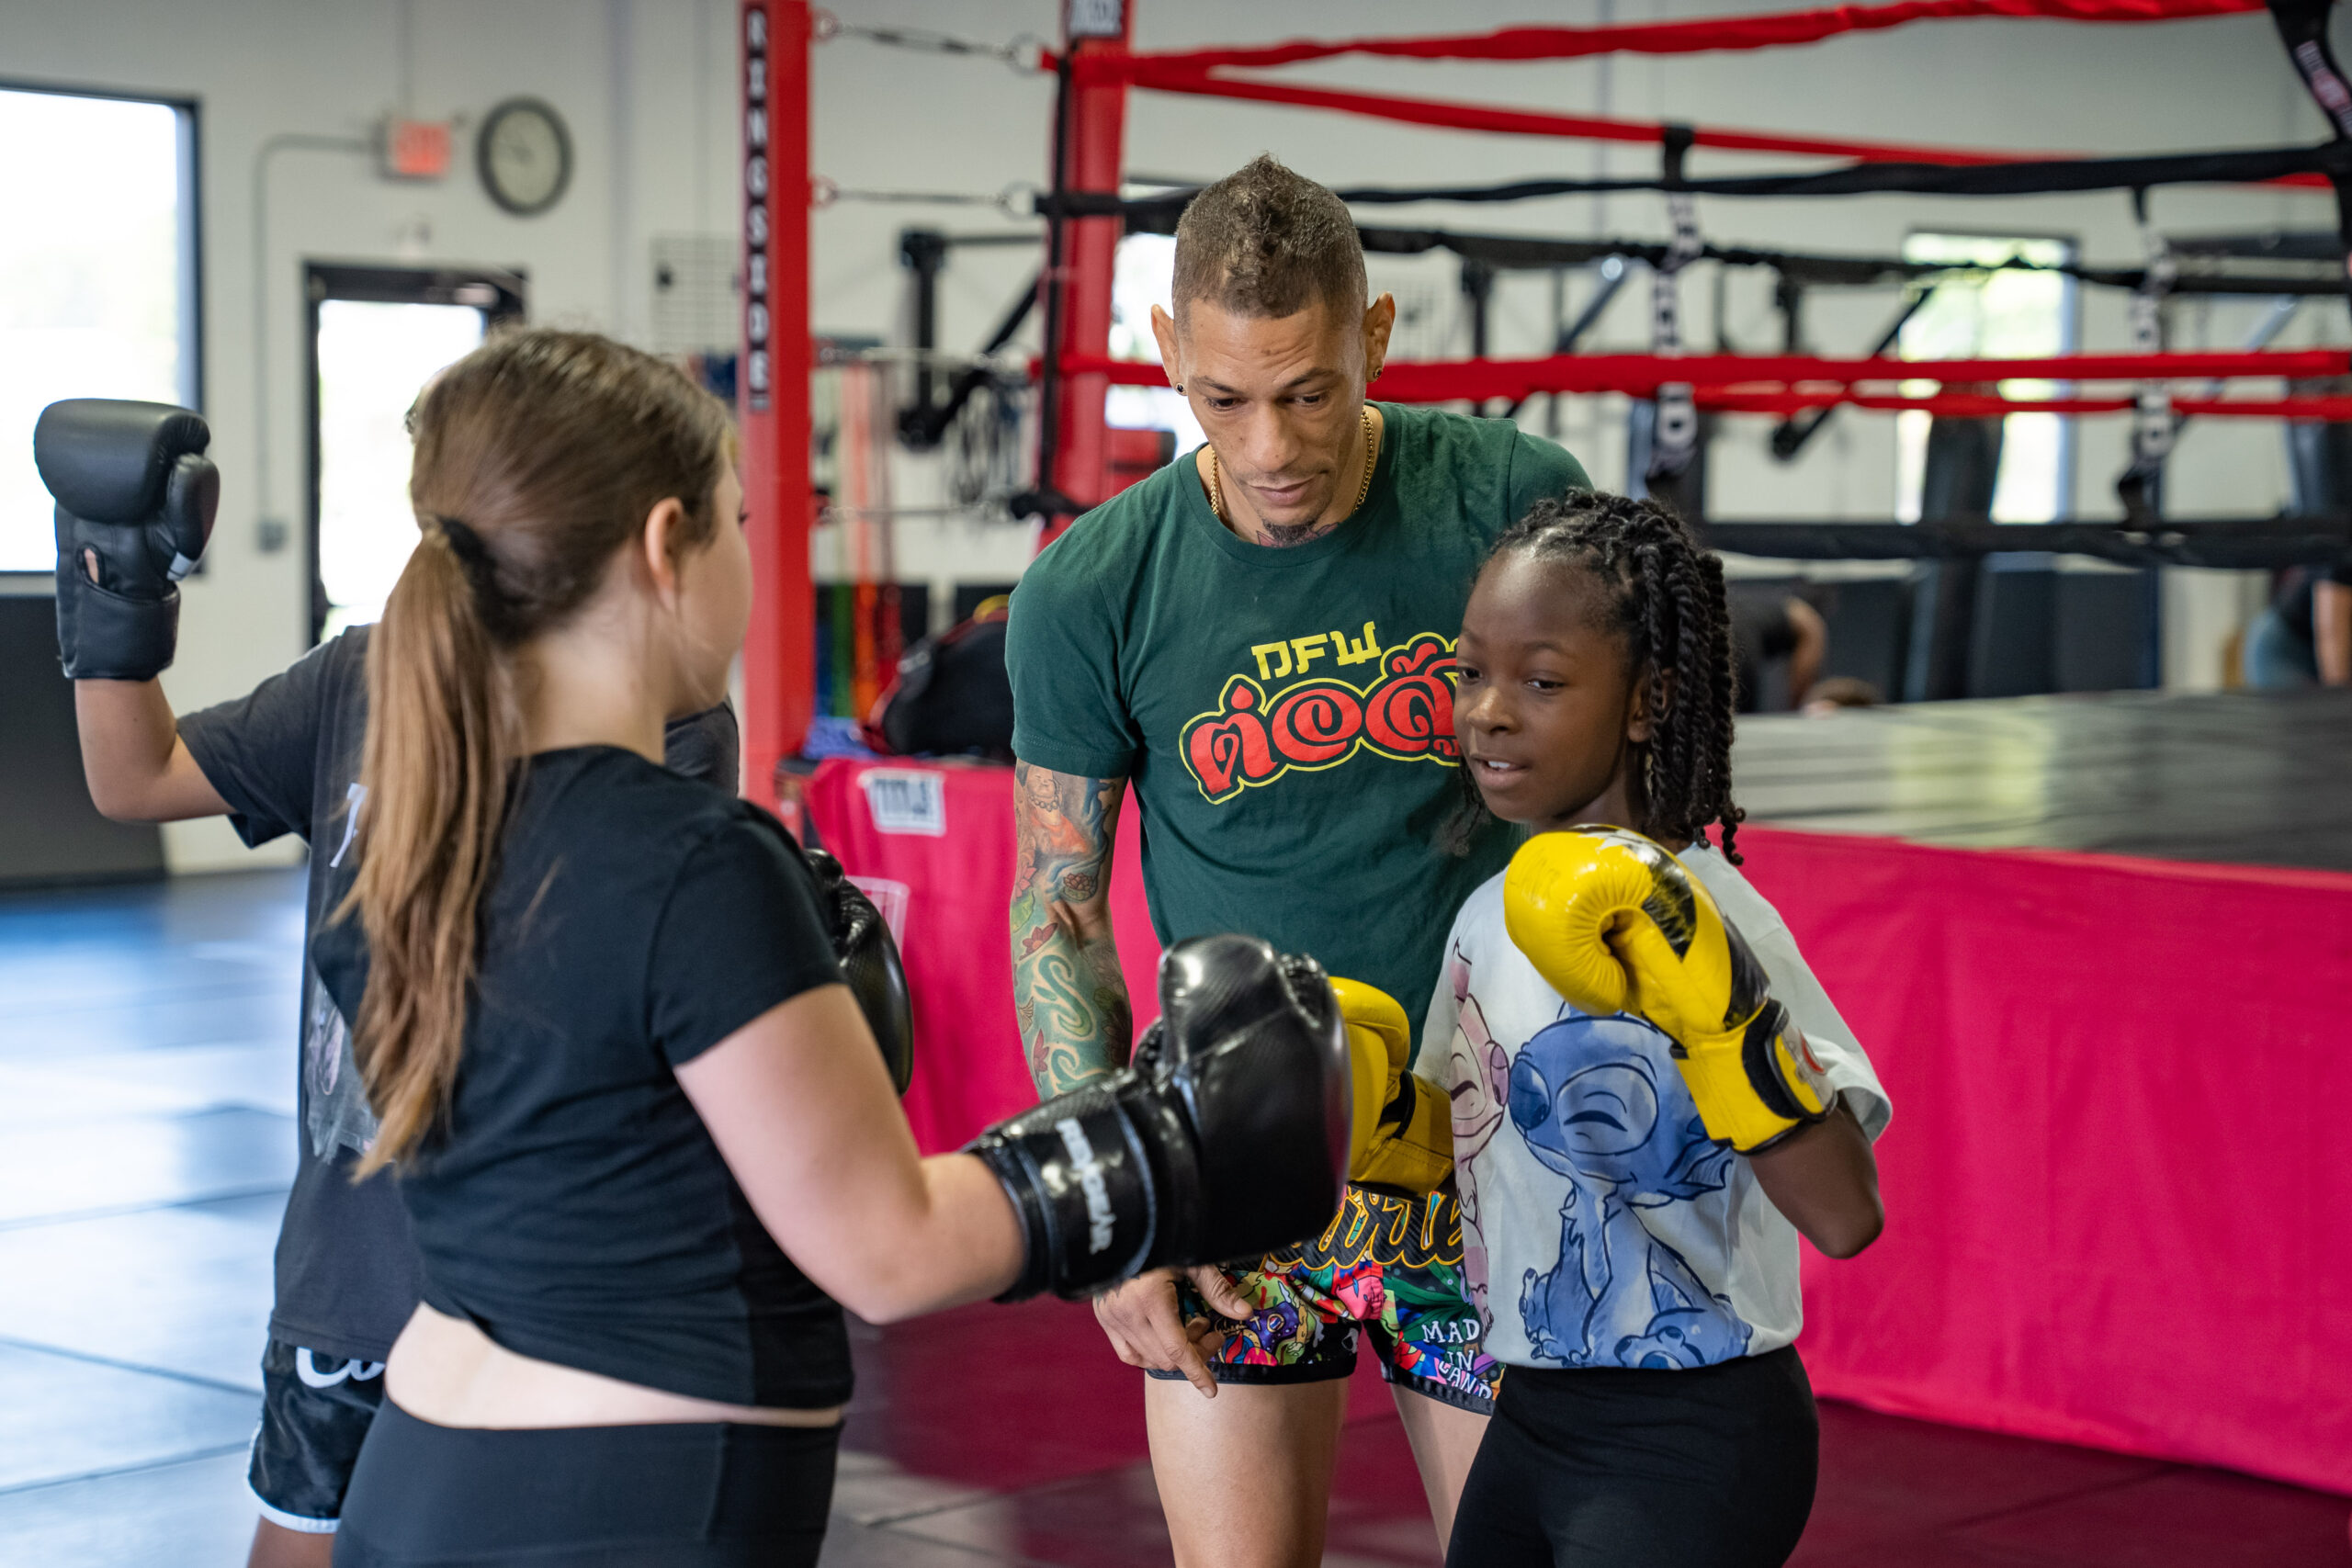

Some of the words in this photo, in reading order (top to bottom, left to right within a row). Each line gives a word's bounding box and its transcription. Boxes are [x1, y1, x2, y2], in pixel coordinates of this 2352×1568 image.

[746, 8, 770, 391] RINGSIDE
[1250, 621, 1382, 681] DFW
[1447, 1349, 1474, 1371] IN
